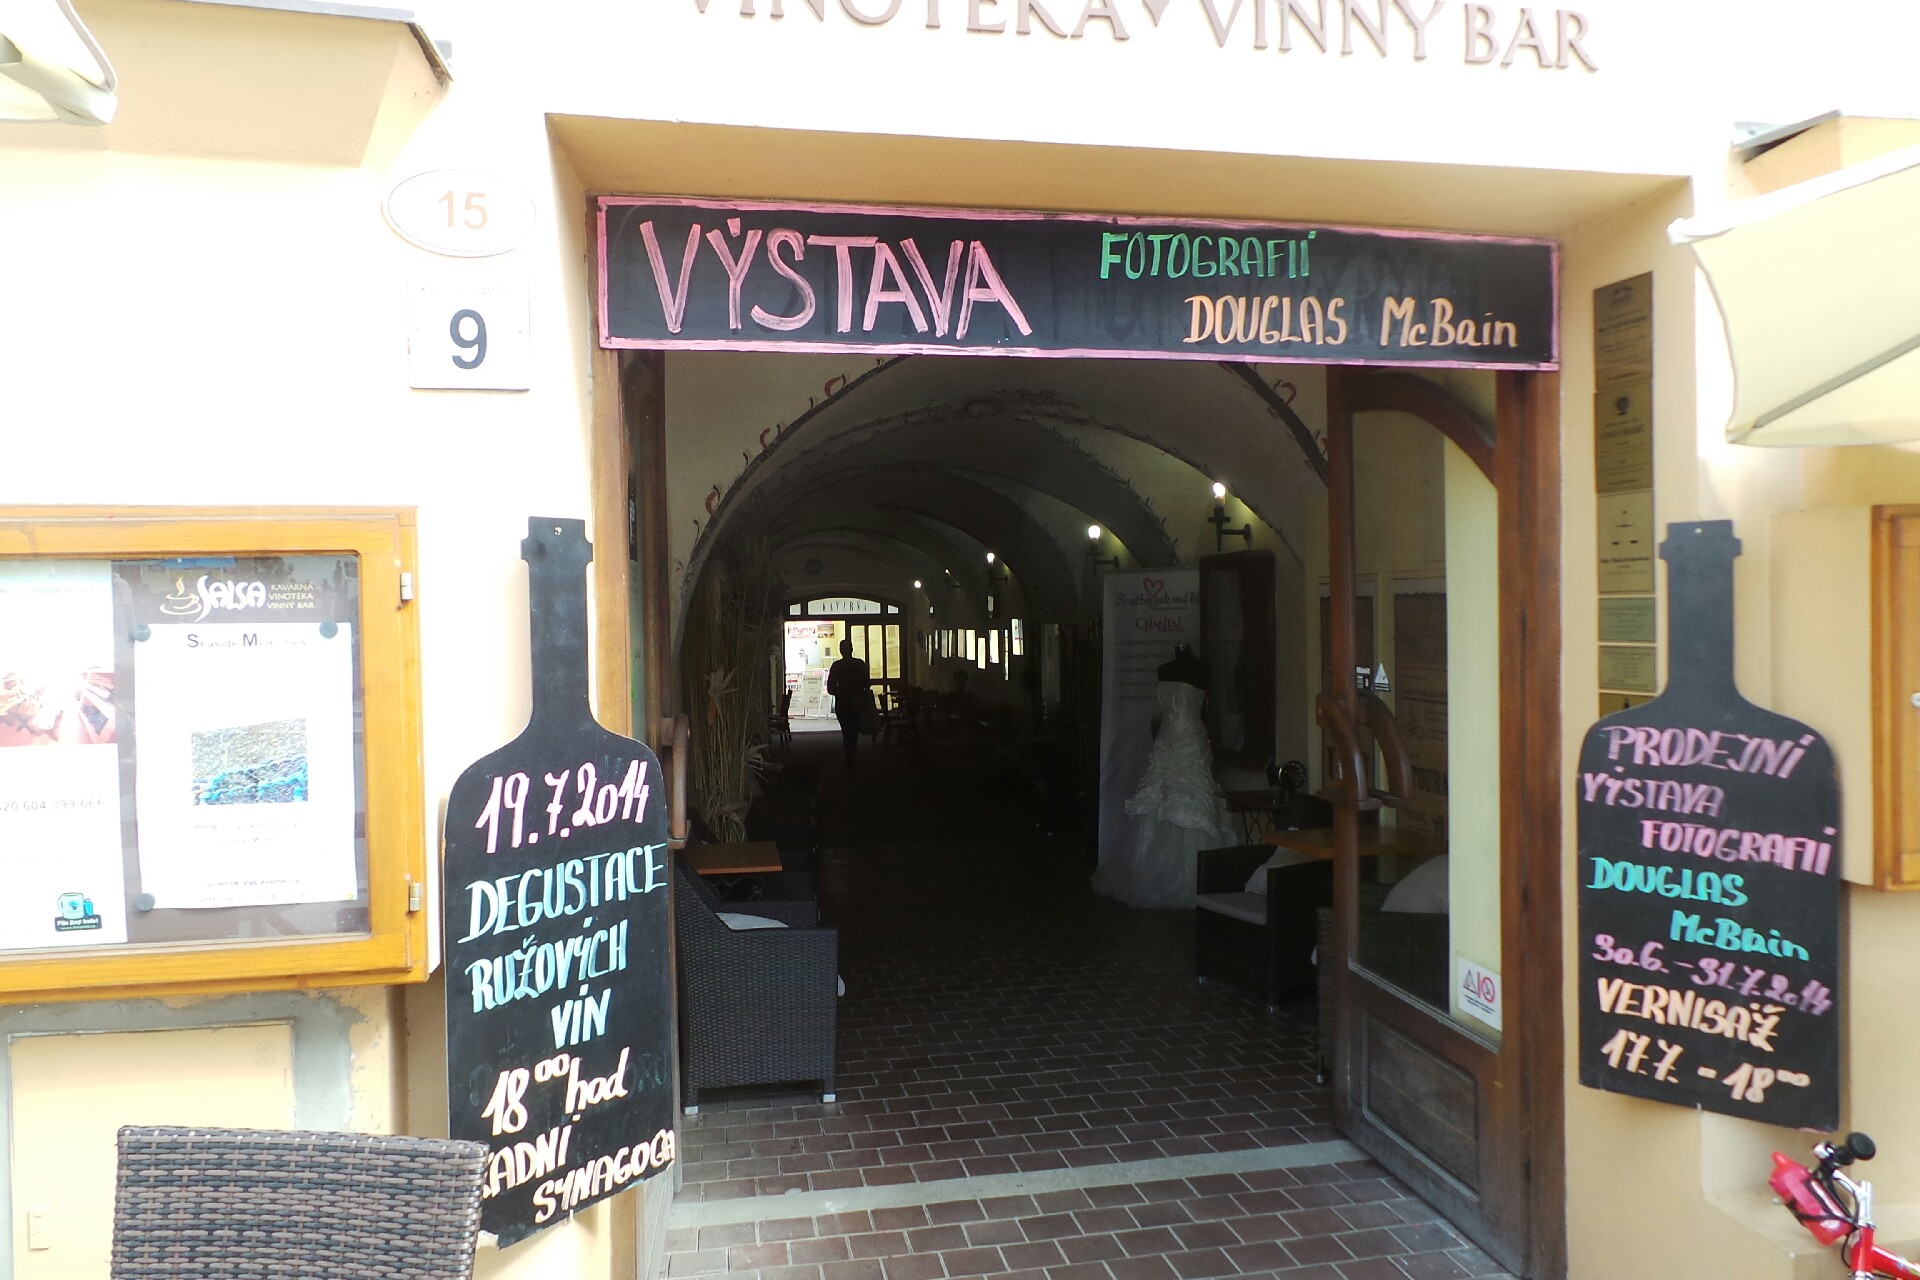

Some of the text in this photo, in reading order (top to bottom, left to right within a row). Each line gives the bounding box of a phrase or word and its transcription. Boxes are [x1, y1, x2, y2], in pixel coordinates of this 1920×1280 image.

[1464, 3, 1600, 72] BAR
[438, 190, 489, 230] 15
[639, 217, 1034, 340] VÝSTAVA
[450, 308, 488, 370] 9
[1182, 294, 1519, 349] DOUGLAS McBain
[297, 601, 316, 610] BAR
[1601, 725, 1817, 778] PRODEJNÍ
[23, 800, 47, 811] 604
[457, 842, 668, 945] DEGUSTACE
[1586, 856, 1748, 907] DOUGLAS
[1668, 909, 1810, 962] McBain
[550, 984, 612, 1050] VÍN
[564, 1045, 631, 1114] hod
[532, 1128, 676, 1225] SYNAGOGA
